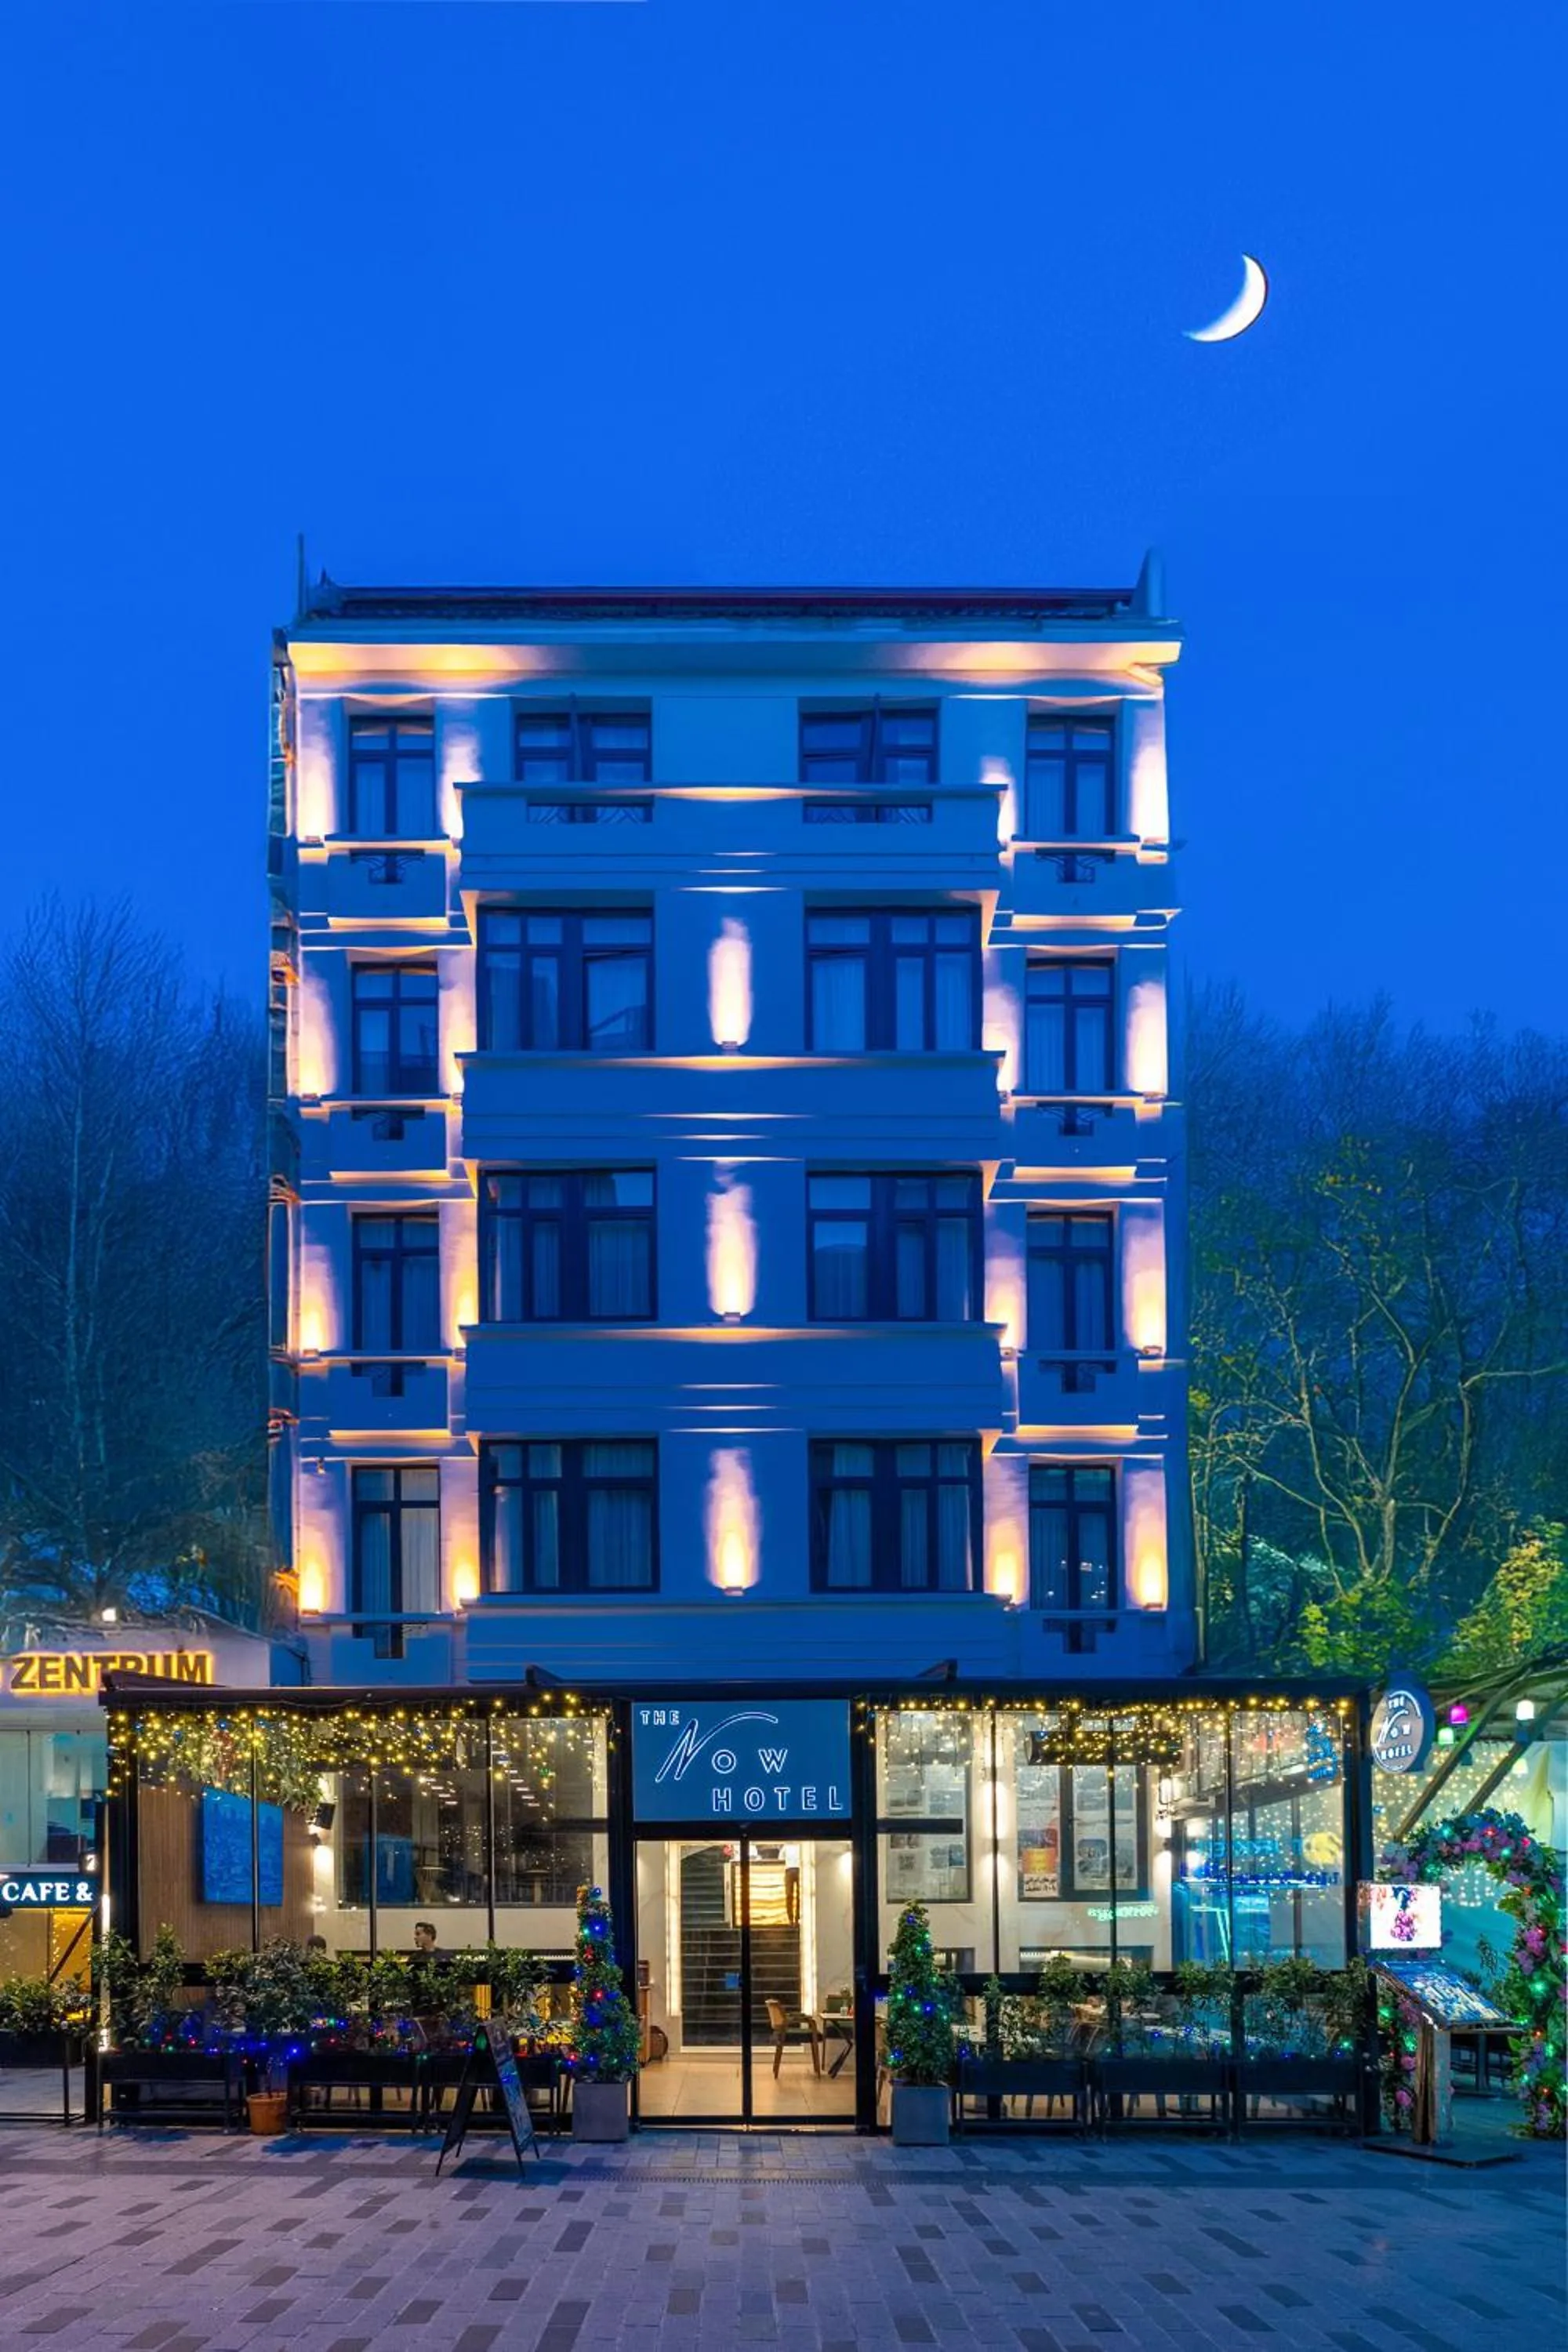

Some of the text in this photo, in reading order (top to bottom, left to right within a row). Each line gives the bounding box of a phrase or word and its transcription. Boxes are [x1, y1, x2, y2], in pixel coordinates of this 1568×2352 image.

[640, 1710, 681, 1726] THE
[655, 1711, 788, 1783] NOW
[712, 1786, 844, 1812] HOTEL
[2, 1882, 93, 1901] CAFE &
